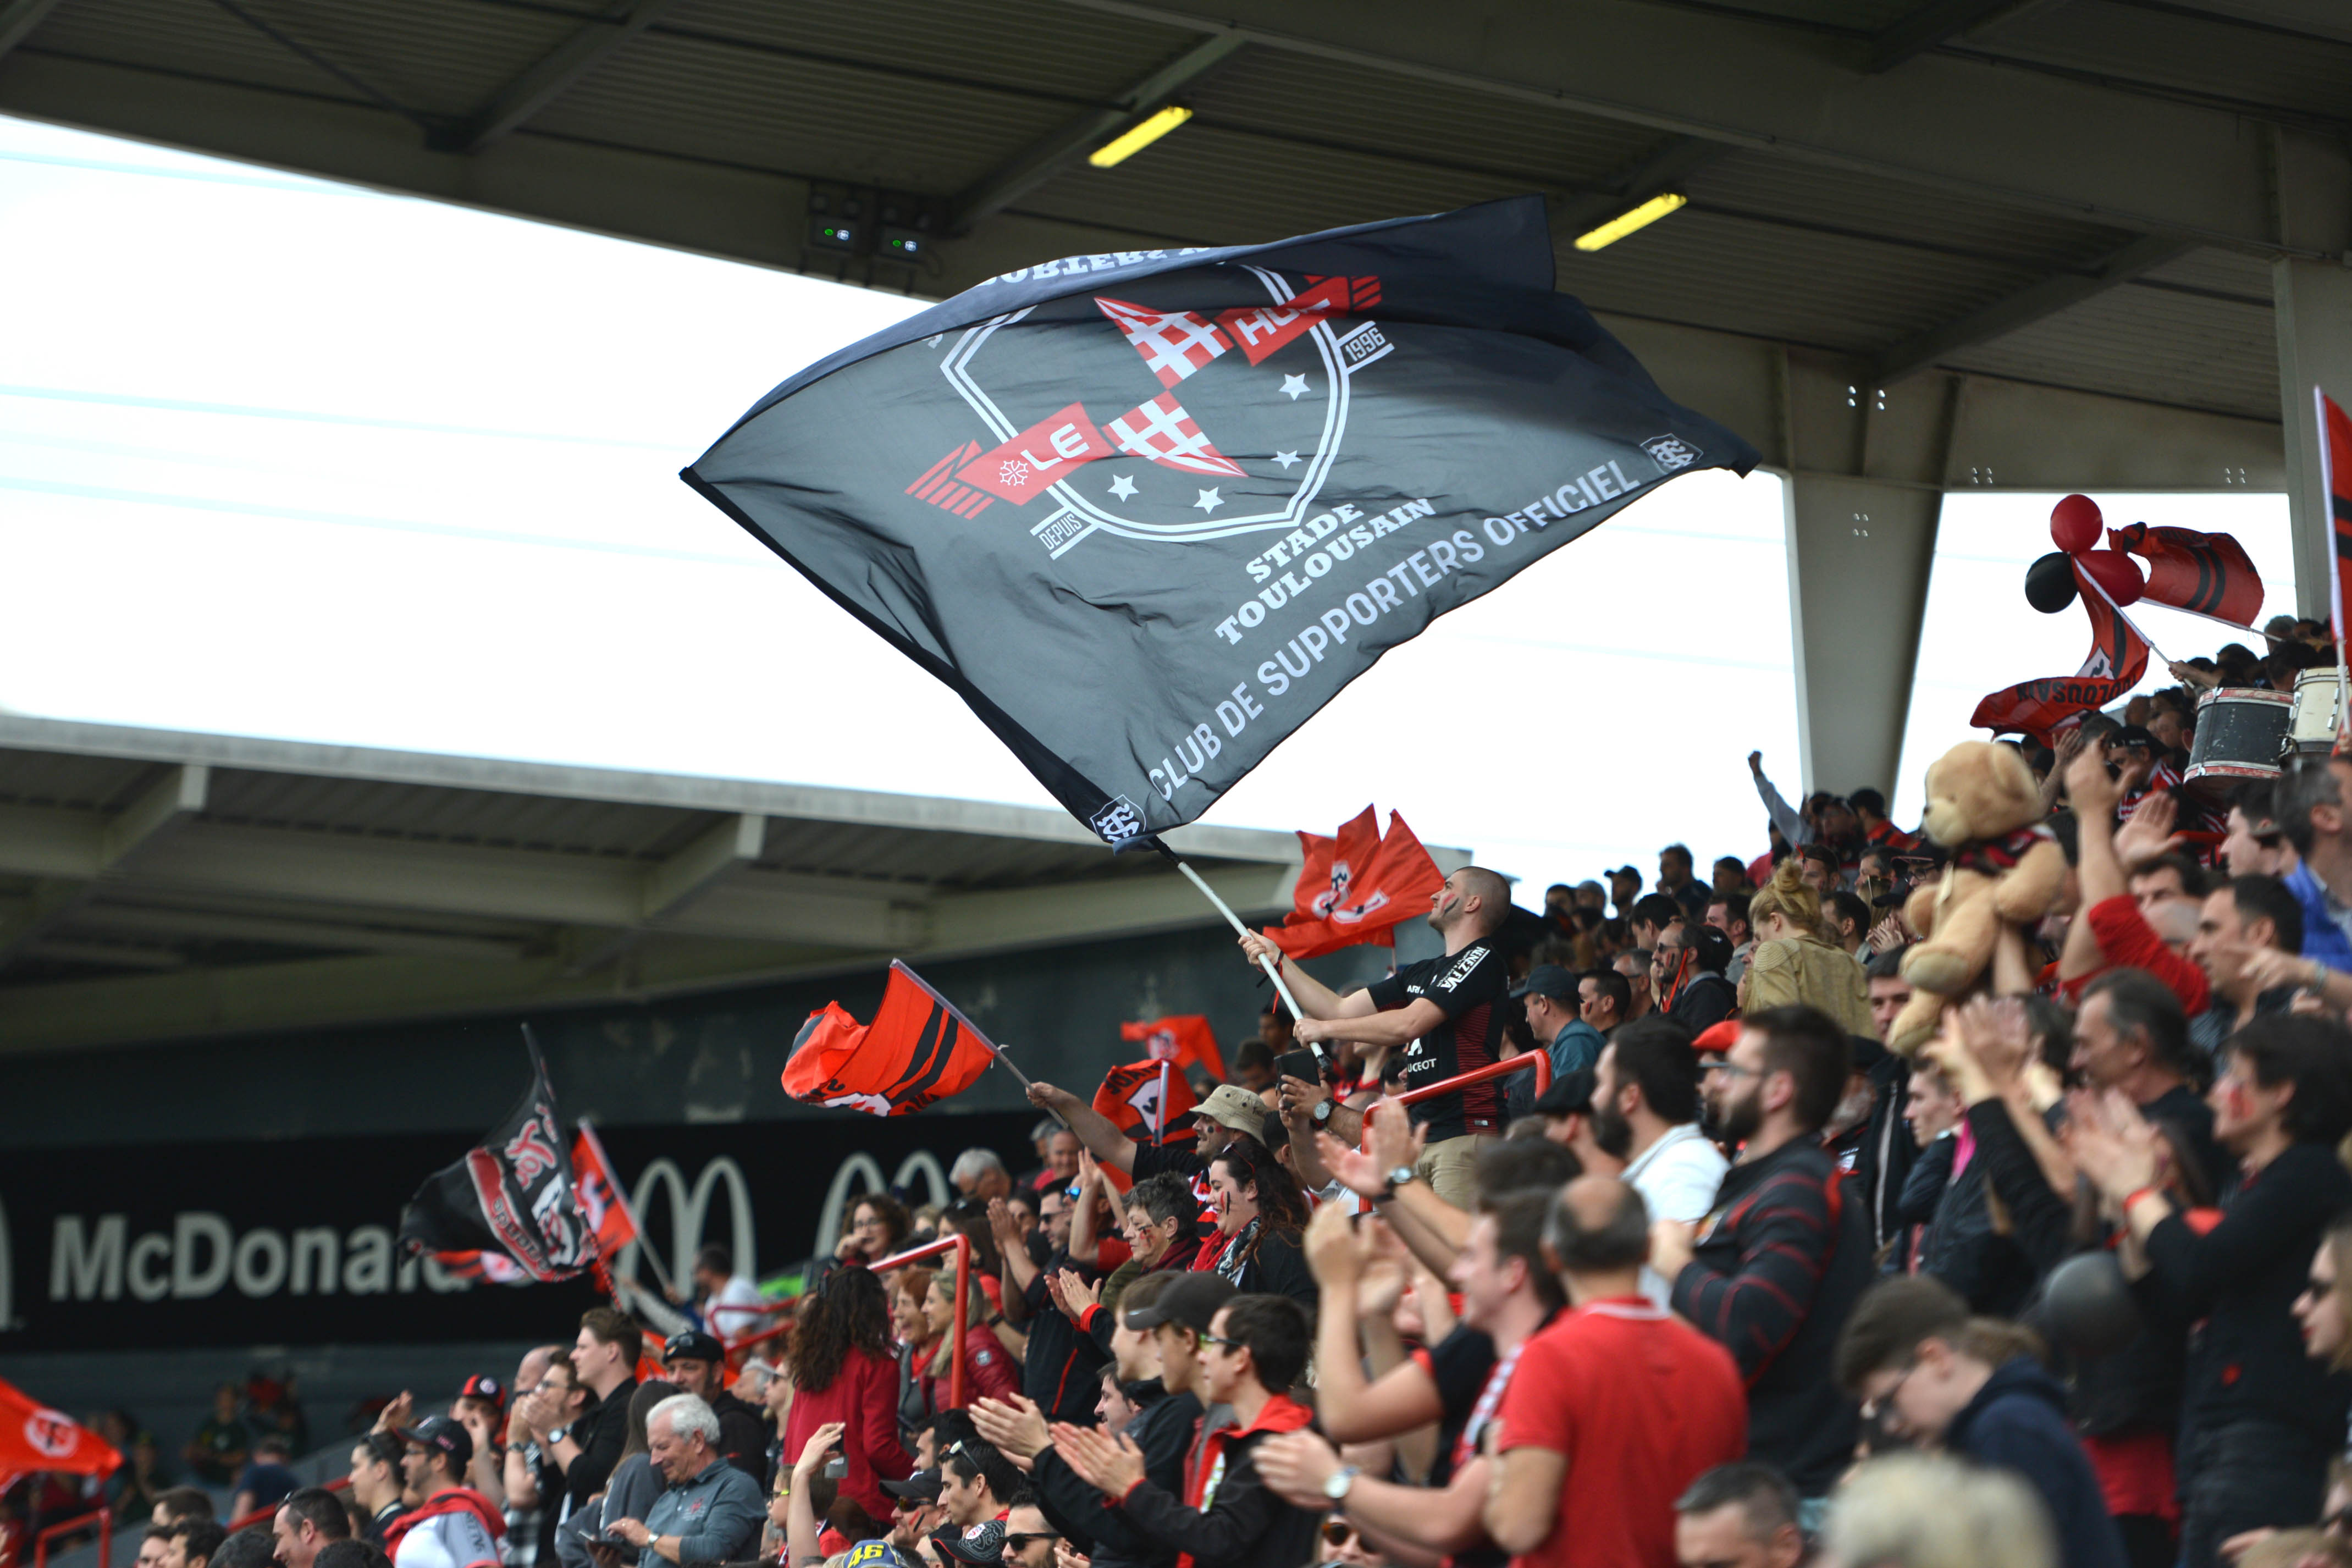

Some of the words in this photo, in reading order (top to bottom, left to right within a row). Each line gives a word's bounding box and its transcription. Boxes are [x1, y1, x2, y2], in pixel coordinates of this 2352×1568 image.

[1020, 423, 1090, 471] LE
[1039, 513, 1083, 551] DEPUIS
[1345, 327, 1386, 362] 1996
[1214, 498, 1437, 645] TOULOUSAIN
[1246, 503, 1365, 584] STADE
[1149, 723, 1222, 802] CLUB
[1215, 682, 1264, 738] DE
[1257, 530, 1484, 696] SUPPORTERS
[1483, 460, 1641, 546] OFFICIEL
[847, 1544, 884, 1568] 46
